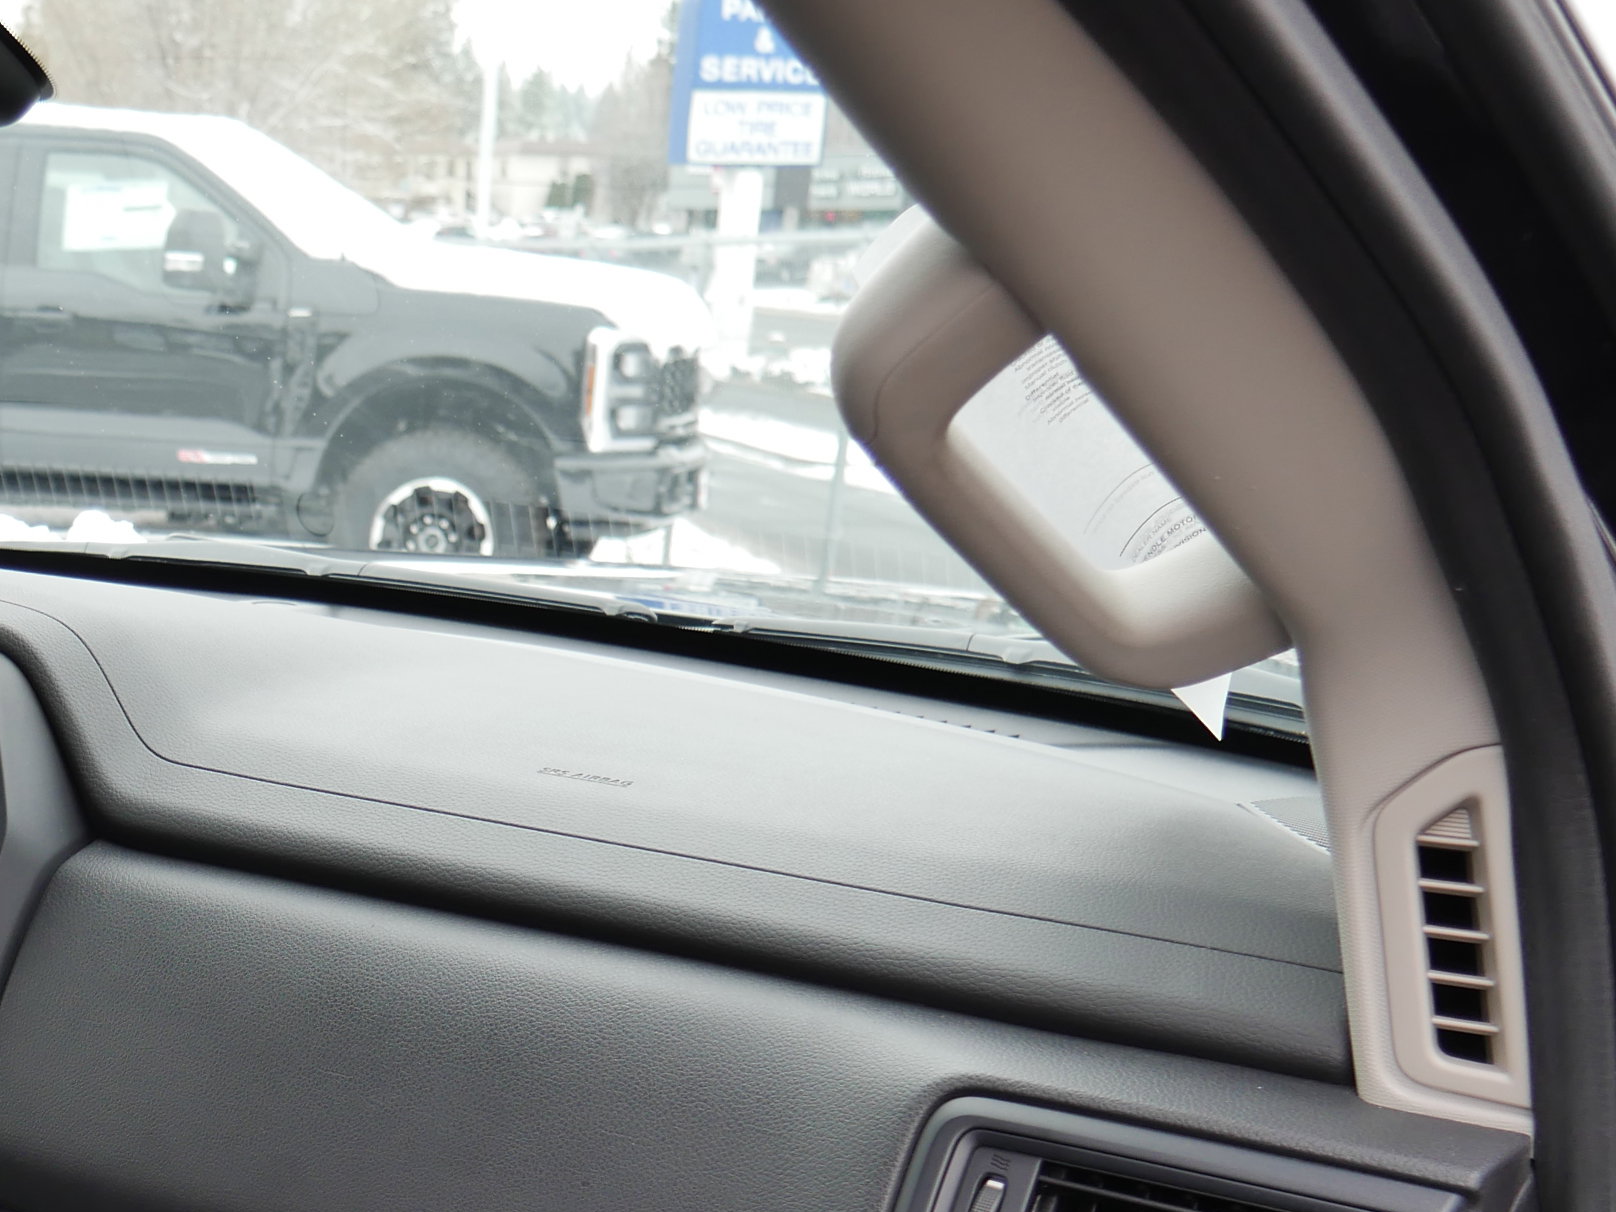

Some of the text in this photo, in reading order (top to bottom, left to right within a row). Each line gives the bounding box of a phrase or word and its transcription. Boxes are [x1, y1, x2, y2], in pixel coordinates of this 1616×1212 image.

[704, 100, 813, 117] LOW PRICE
[696, 139, 813, 158] GUARANTEE
